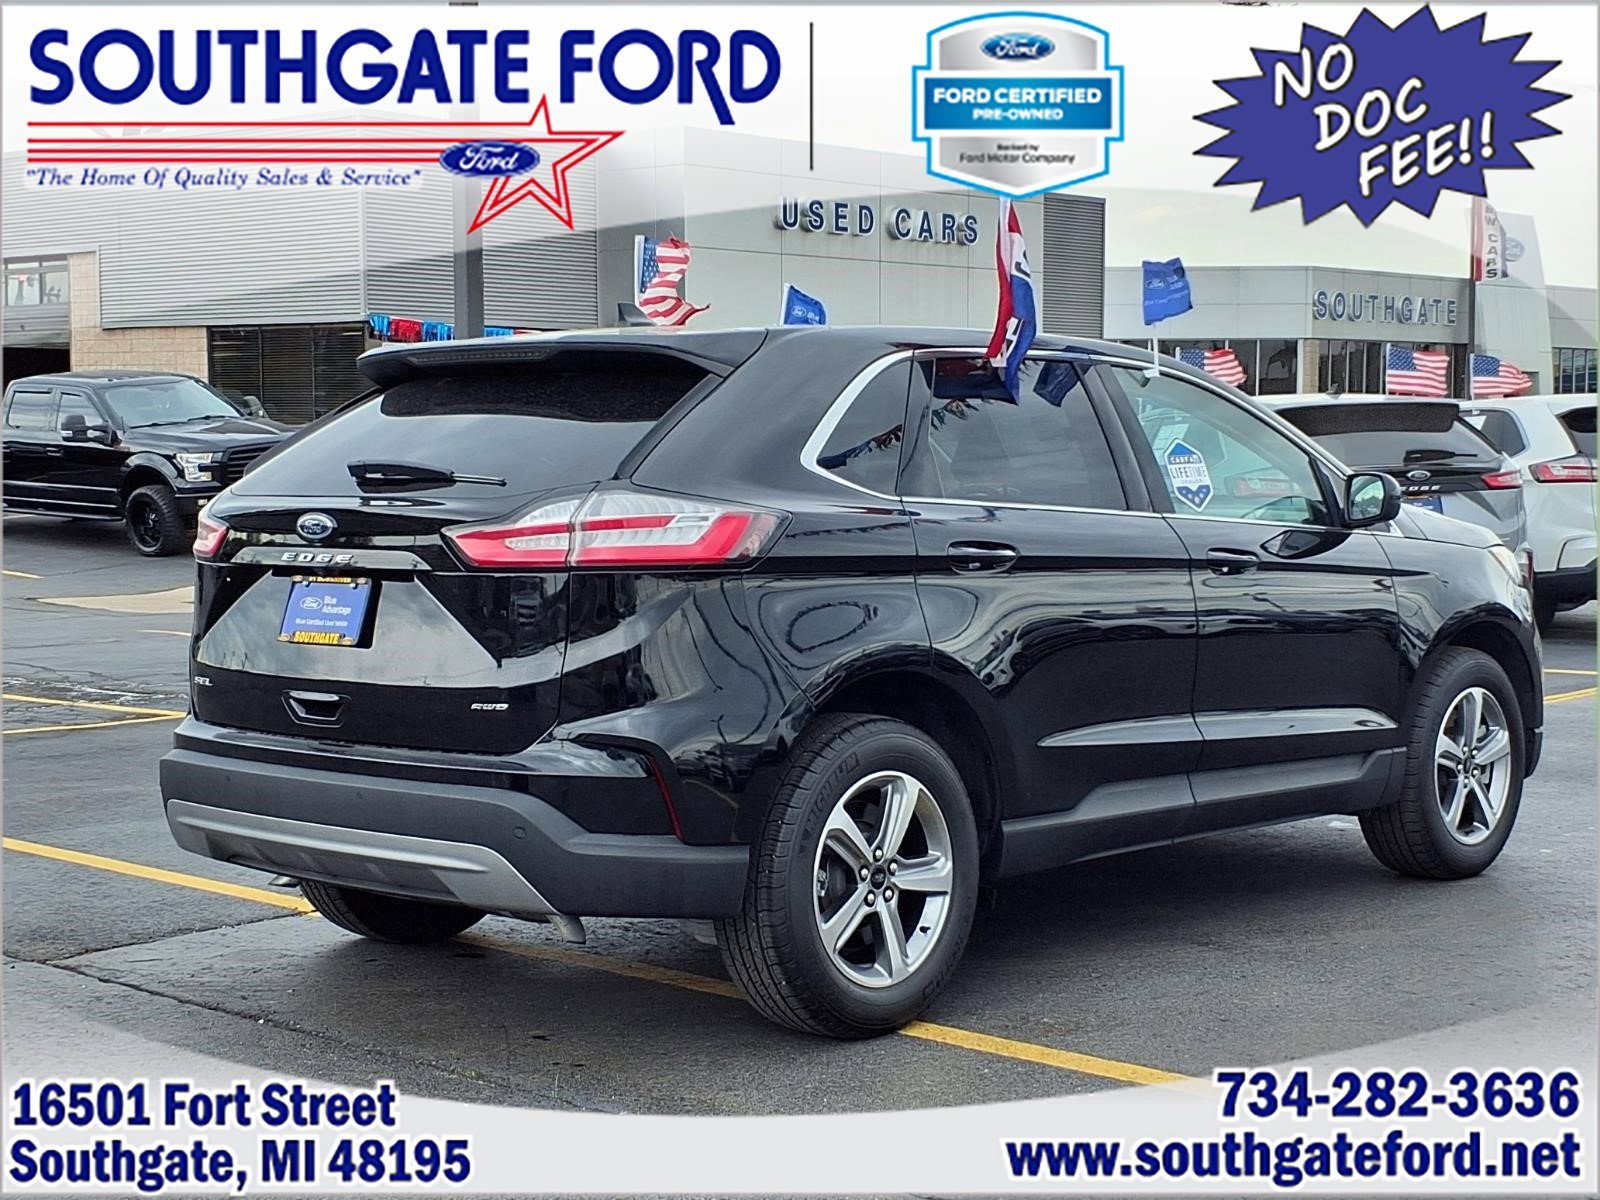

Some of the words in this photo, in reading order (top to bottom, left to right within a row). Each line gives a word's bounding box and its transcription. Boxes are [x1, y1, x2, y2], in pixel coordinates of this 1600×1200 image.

[778, 196, 875, 236] USED
[892, 207, 979, 246] CARS
[1485, 233, 1499, 279] CARS
[1313, 289, 1457, 326] SOUTHGATE
[1169, 465, 1207, 479] LIFETIME
[281, 552, 354, 564] EDGE
[323, 595, 338, 605] Blue
[322, 605, 352, 615] Advantage
[293, 631, 340, 645] SOUTHGATE
[193, 675, 213, 687] SEL
[470, 703, 509, 711] AWD
